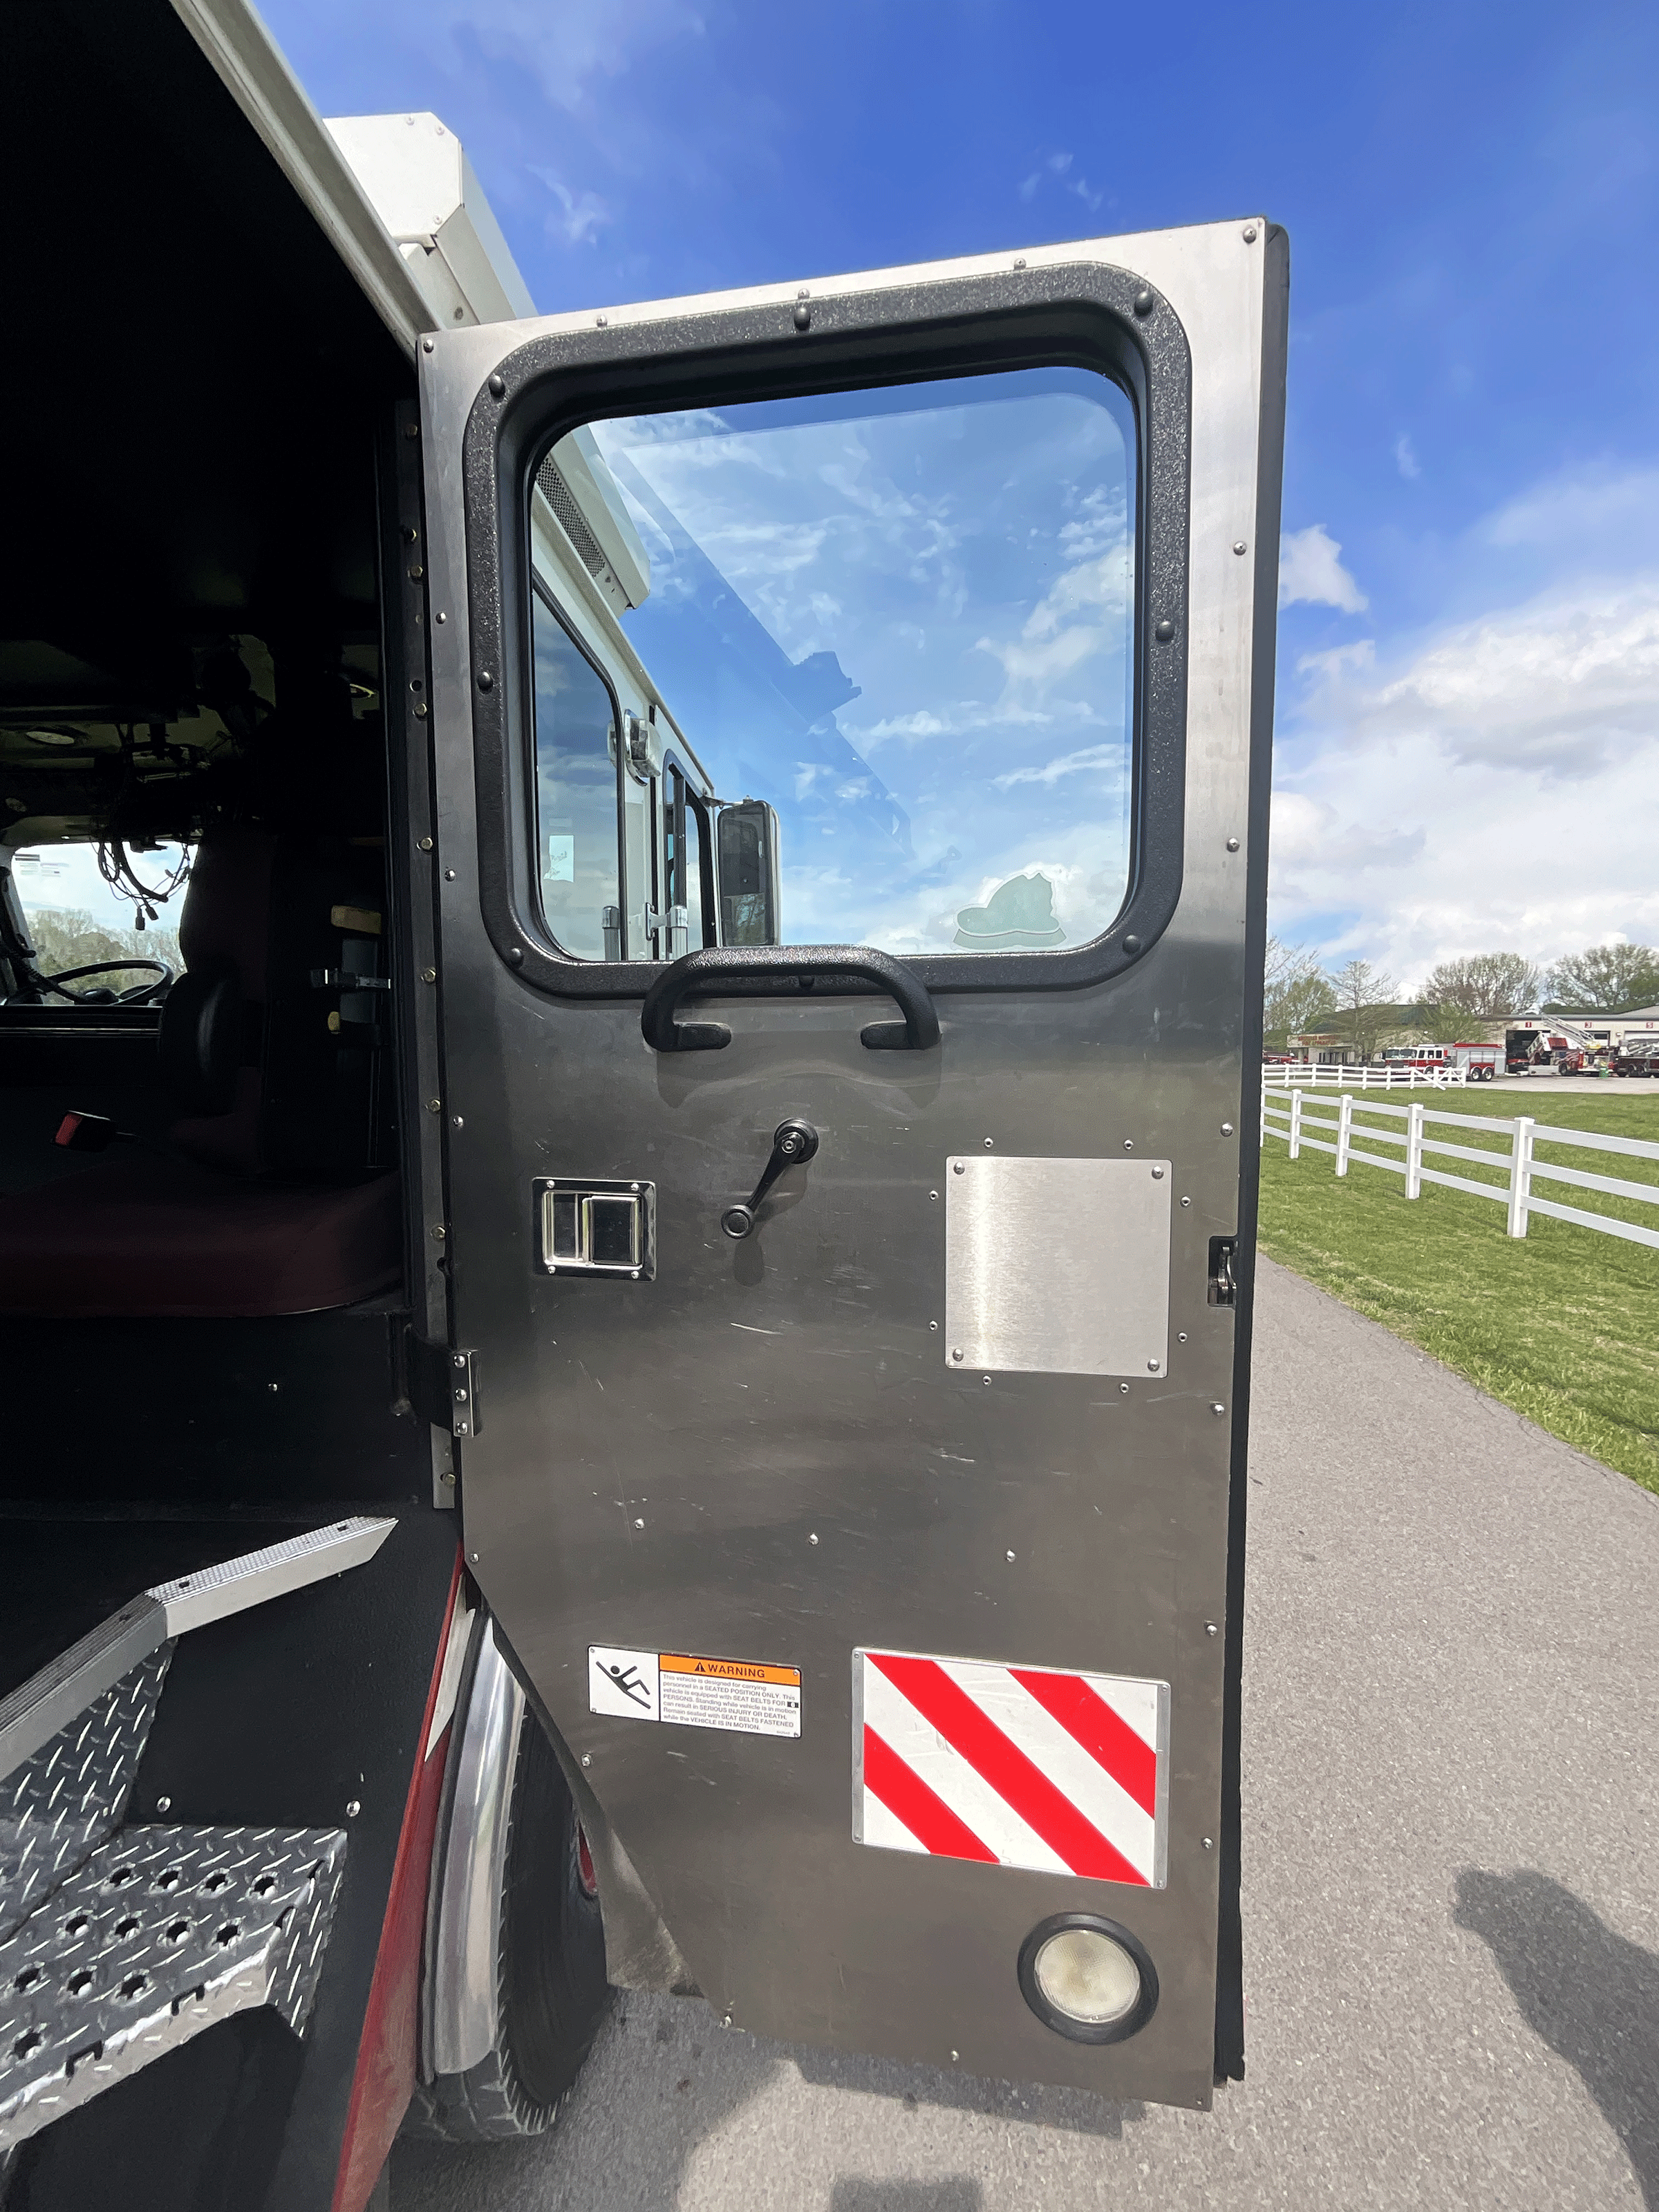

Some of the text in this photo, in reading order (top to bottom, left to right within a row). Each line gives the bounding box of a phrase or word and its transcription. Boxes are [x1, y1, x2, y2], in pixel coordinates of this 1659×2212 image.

[708, 1664, 765, 1678] WARNING
[730, 1688, 760, 1696] POSITION
[695, 1697, 721, 1706] Standing
[760, 1718, 794, 1727] FASTENED
